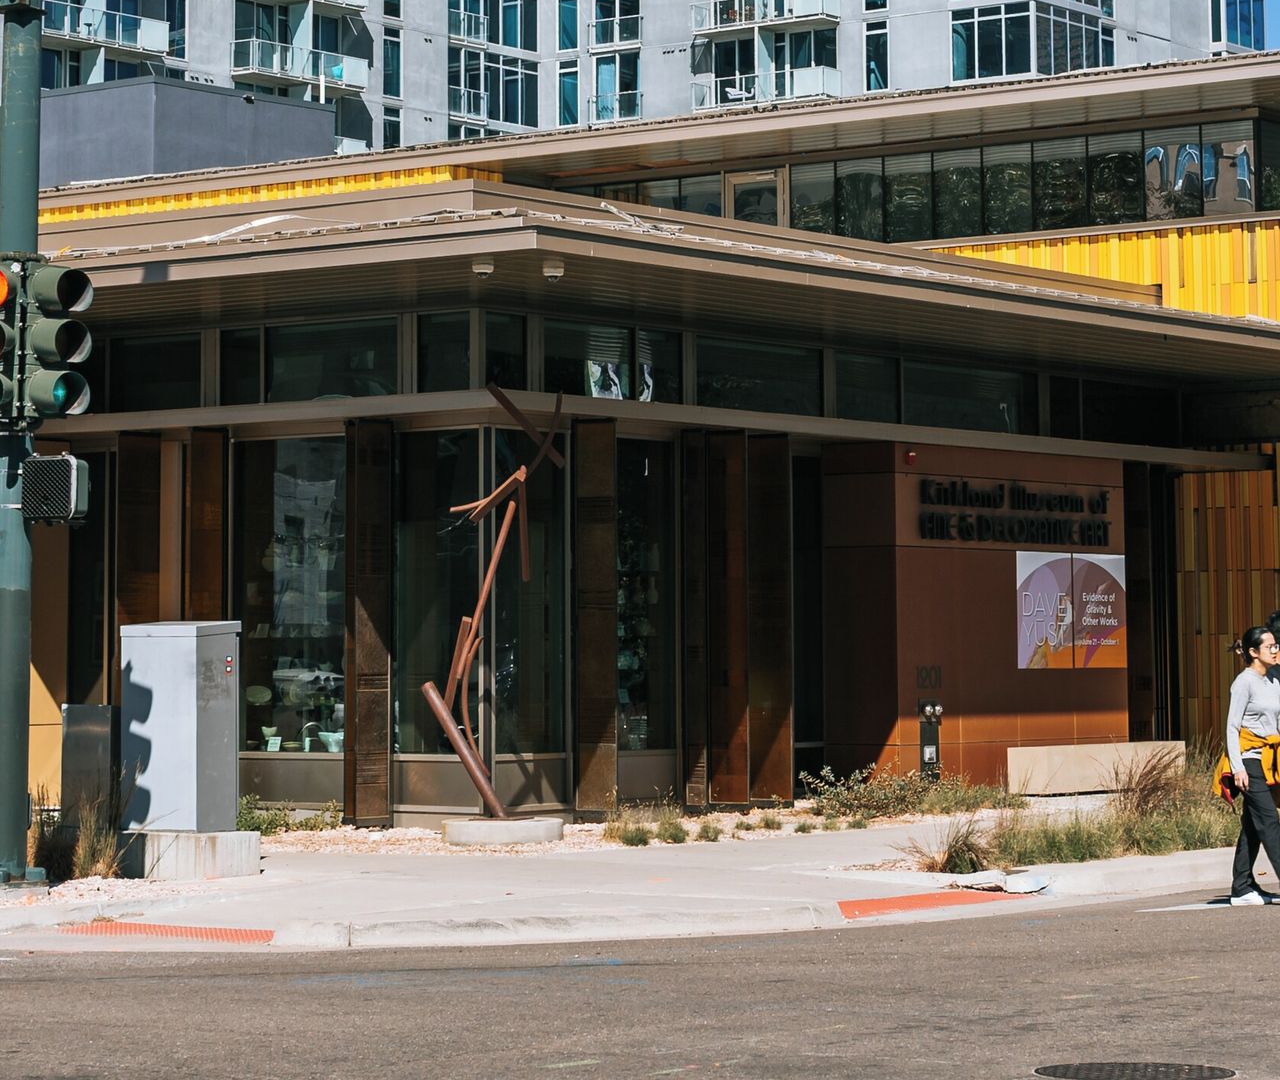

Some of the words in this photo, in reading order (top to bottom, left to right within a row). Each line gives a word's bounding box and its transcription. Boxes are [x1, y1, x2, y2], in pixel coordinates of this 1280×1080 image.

[1083, 593, 1108, 601] Evidence
[1109, 593, 1115, 601] of
[1023, 592, 1066, 616] DAVE
[1086, 605, 1107, 615] Gravity
[1082, 617, 1098, 625] Other
[1100, 617, 1118, 625] Works
